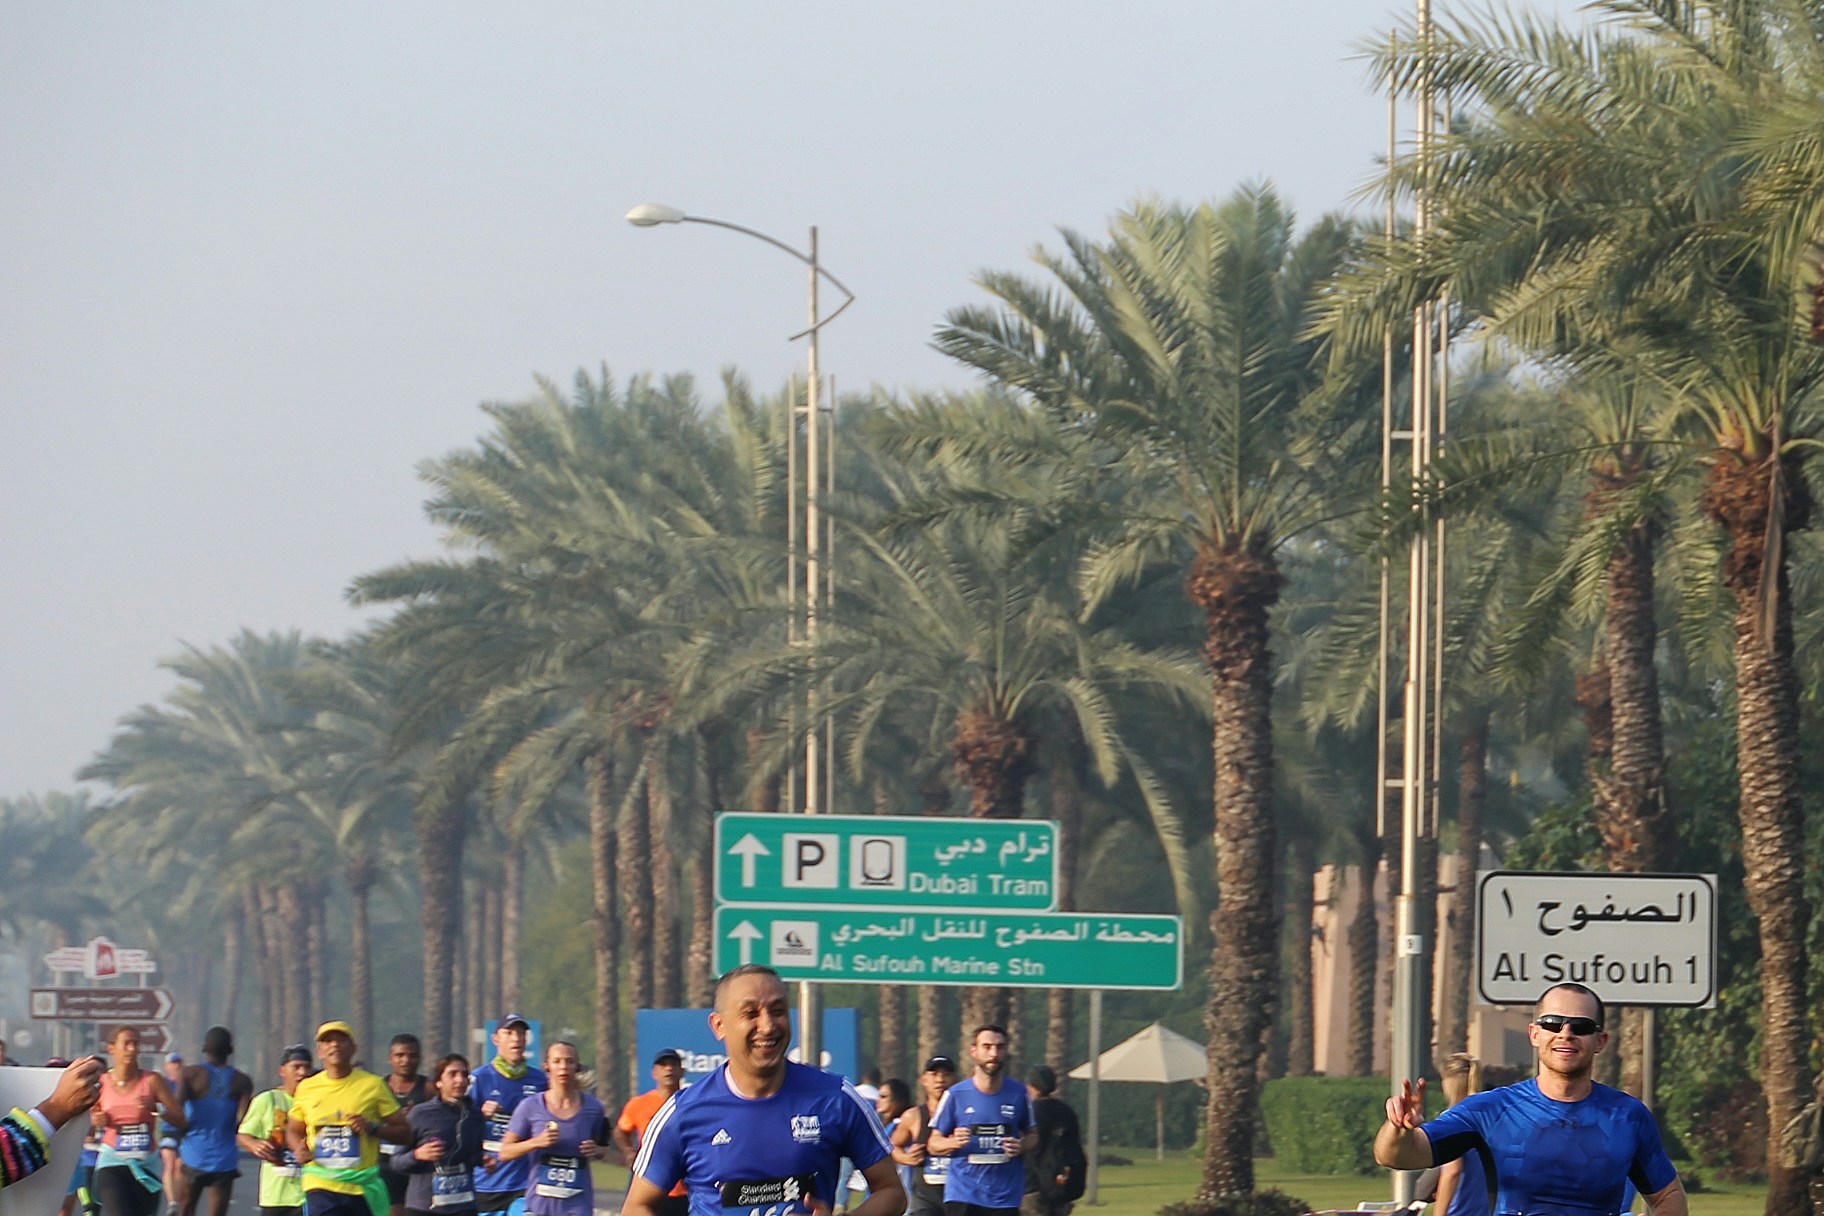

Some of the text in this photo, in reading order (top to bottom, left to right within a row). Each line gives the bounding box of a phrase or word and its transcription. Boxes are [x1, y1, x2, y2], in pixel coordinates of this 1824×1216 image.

[933, 832, 1050, 866] ترام دبي
[908, 872, 1048, 896] Dubai Tram
[1536, 889, 1697, 936] الصفوح
[830, 918, 1175, 949] محطة الصفوح للنقل البحري
[820, 953, 1044, 976] Al Sufouh Marine Stn
[1492, 952, 1697, 984] Al Sufouh 1
[741, 1182, 782, 1195] Standard
